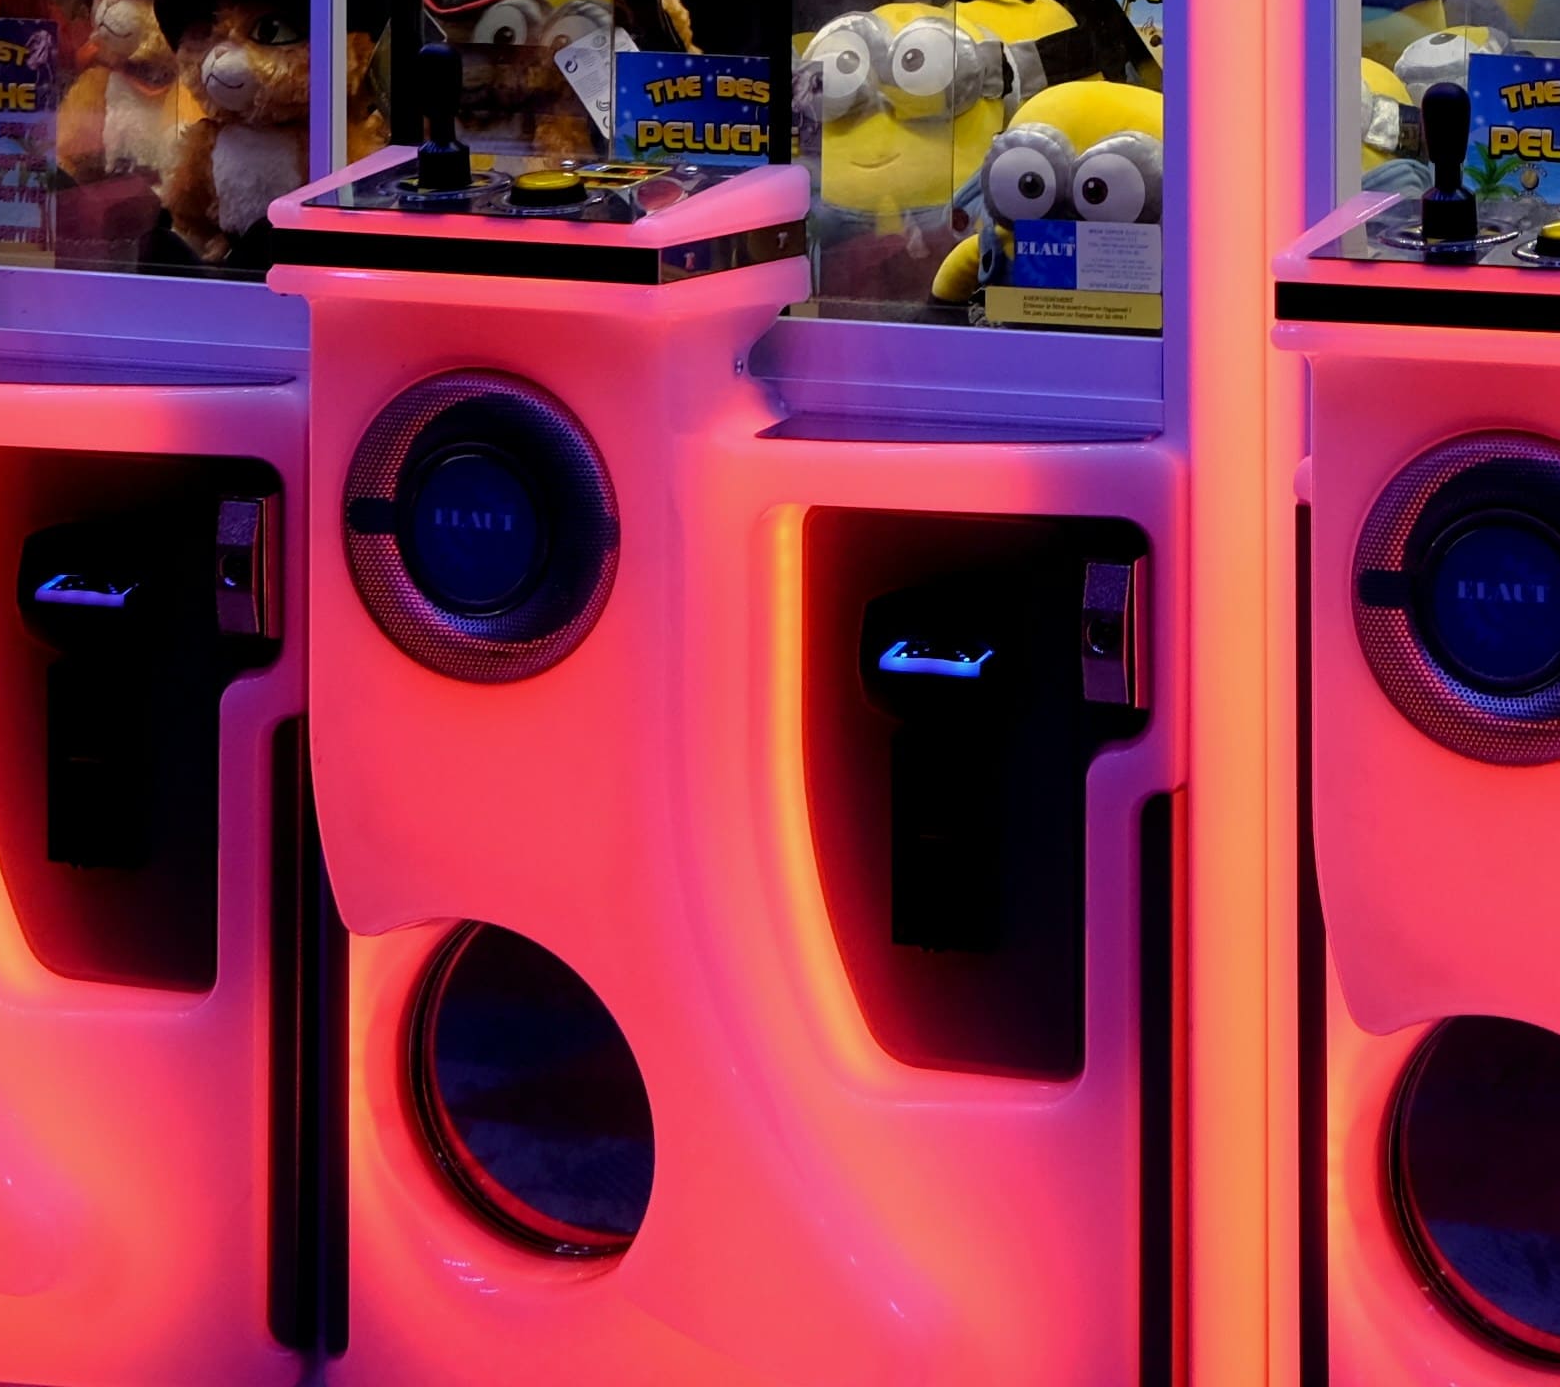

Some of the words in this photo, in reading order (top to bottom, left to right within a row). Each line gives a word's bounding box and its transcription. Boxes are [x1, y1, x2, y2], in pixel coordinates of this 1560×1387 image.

[646, 76, 702, 104] THE
[717, 76, 770, 104] BES
[1017, 241, 1076, 257] ELAUT
